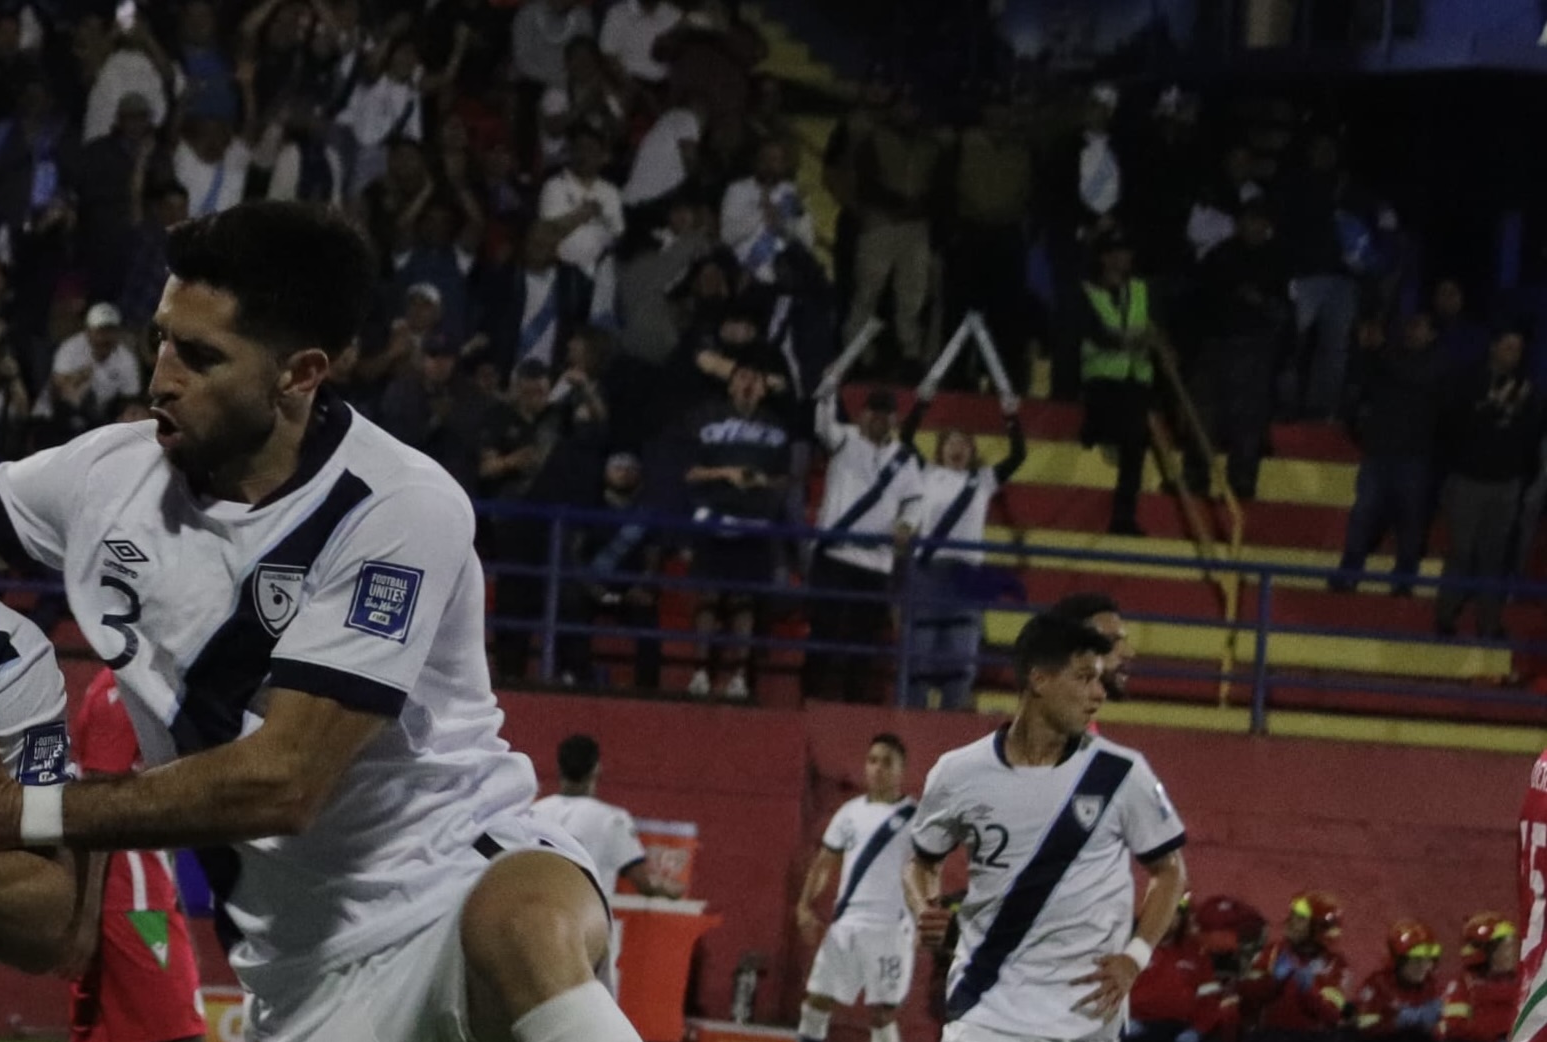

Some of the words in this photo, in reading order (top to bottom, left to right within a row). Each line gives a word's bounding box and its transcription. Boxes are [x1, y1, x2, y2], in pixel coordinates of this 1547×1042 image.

[369, 583, 408, 603] UNITES
[372, 573, 408, 590] FOOTBALL
[101, 576, 140, 670] 3
[959, 823, 1009, 868] 22
[878, 955, 902, 981] 18
